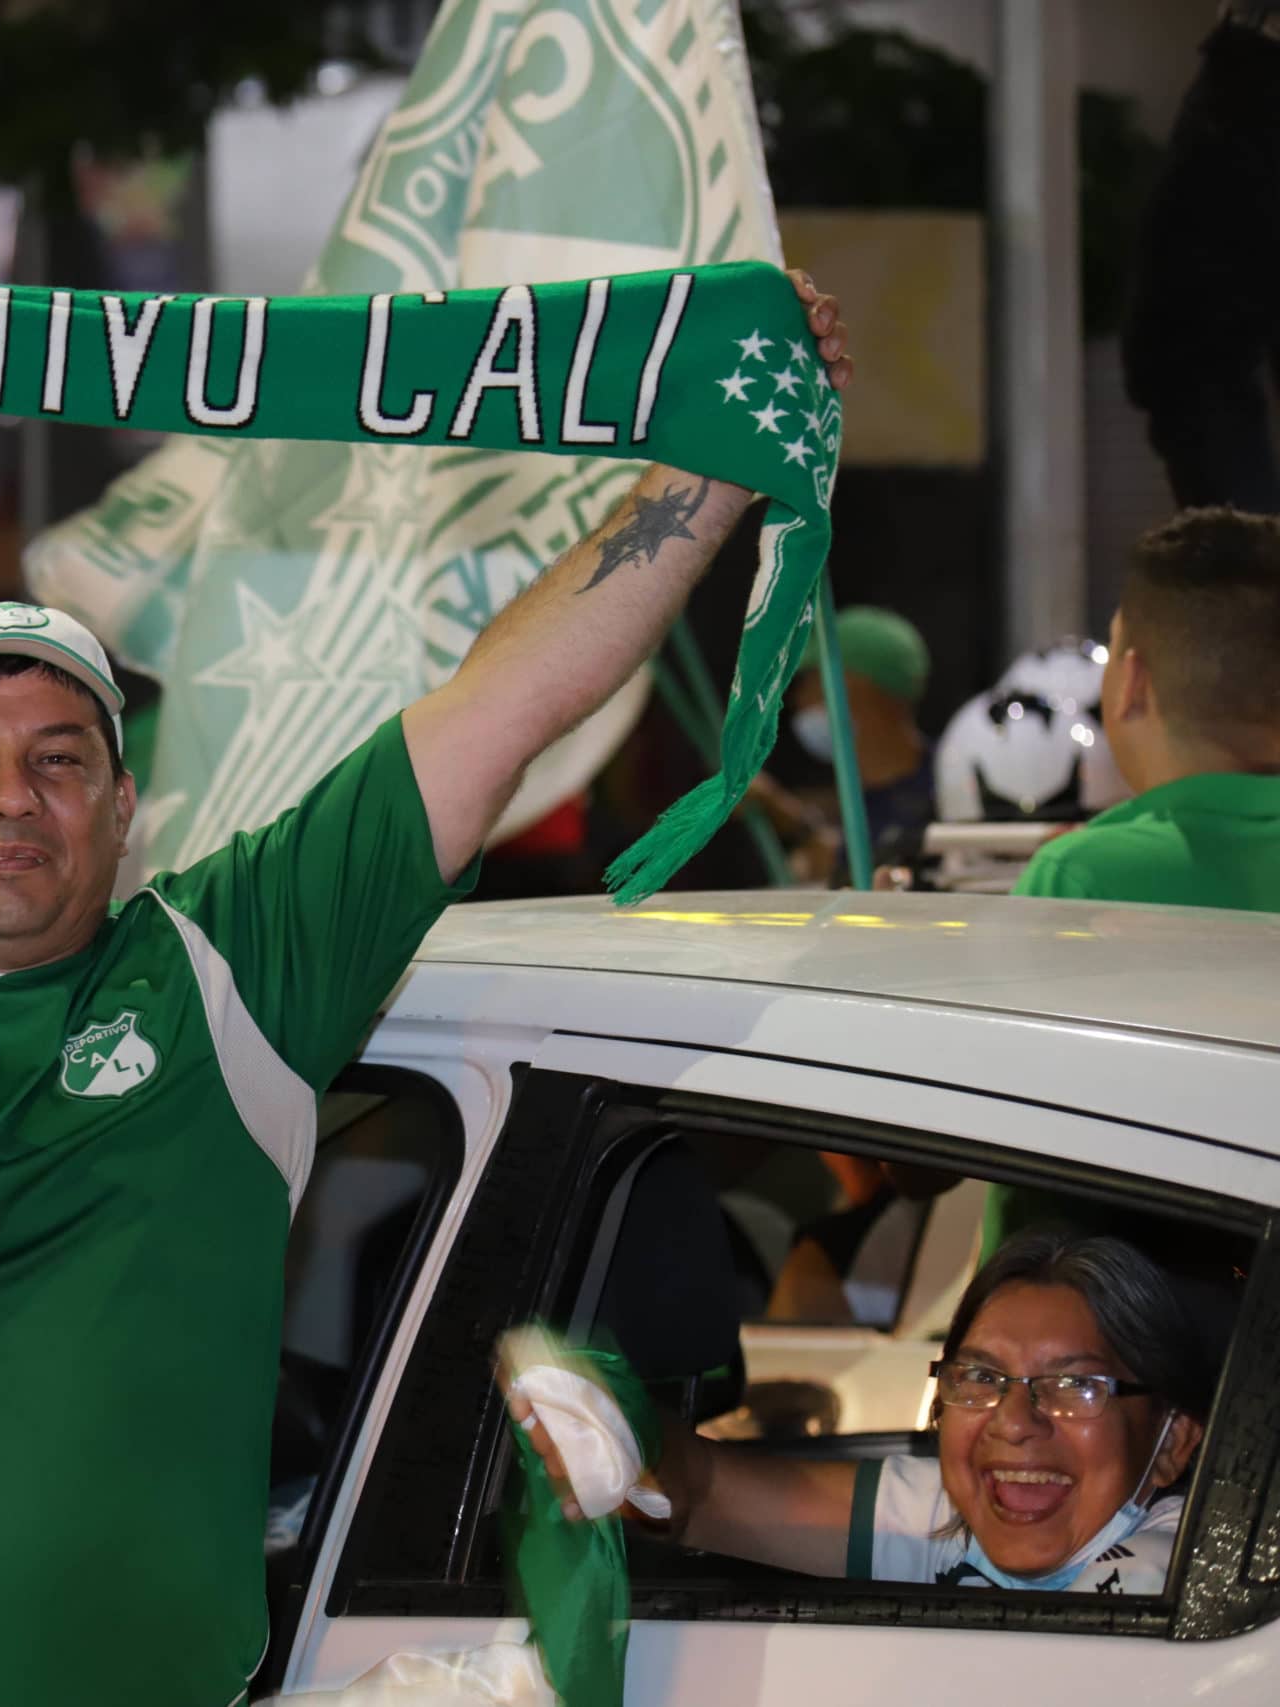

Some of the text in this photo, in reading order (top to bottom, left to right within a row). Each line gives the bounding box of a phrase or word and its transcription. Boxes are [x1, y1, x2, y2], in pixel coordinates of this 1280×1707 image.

[356, 271, 695, 446] CALI
[65, 1023, 129, 1053] DEPORTIVO
[70, 1049, 146, 1077] CALI
